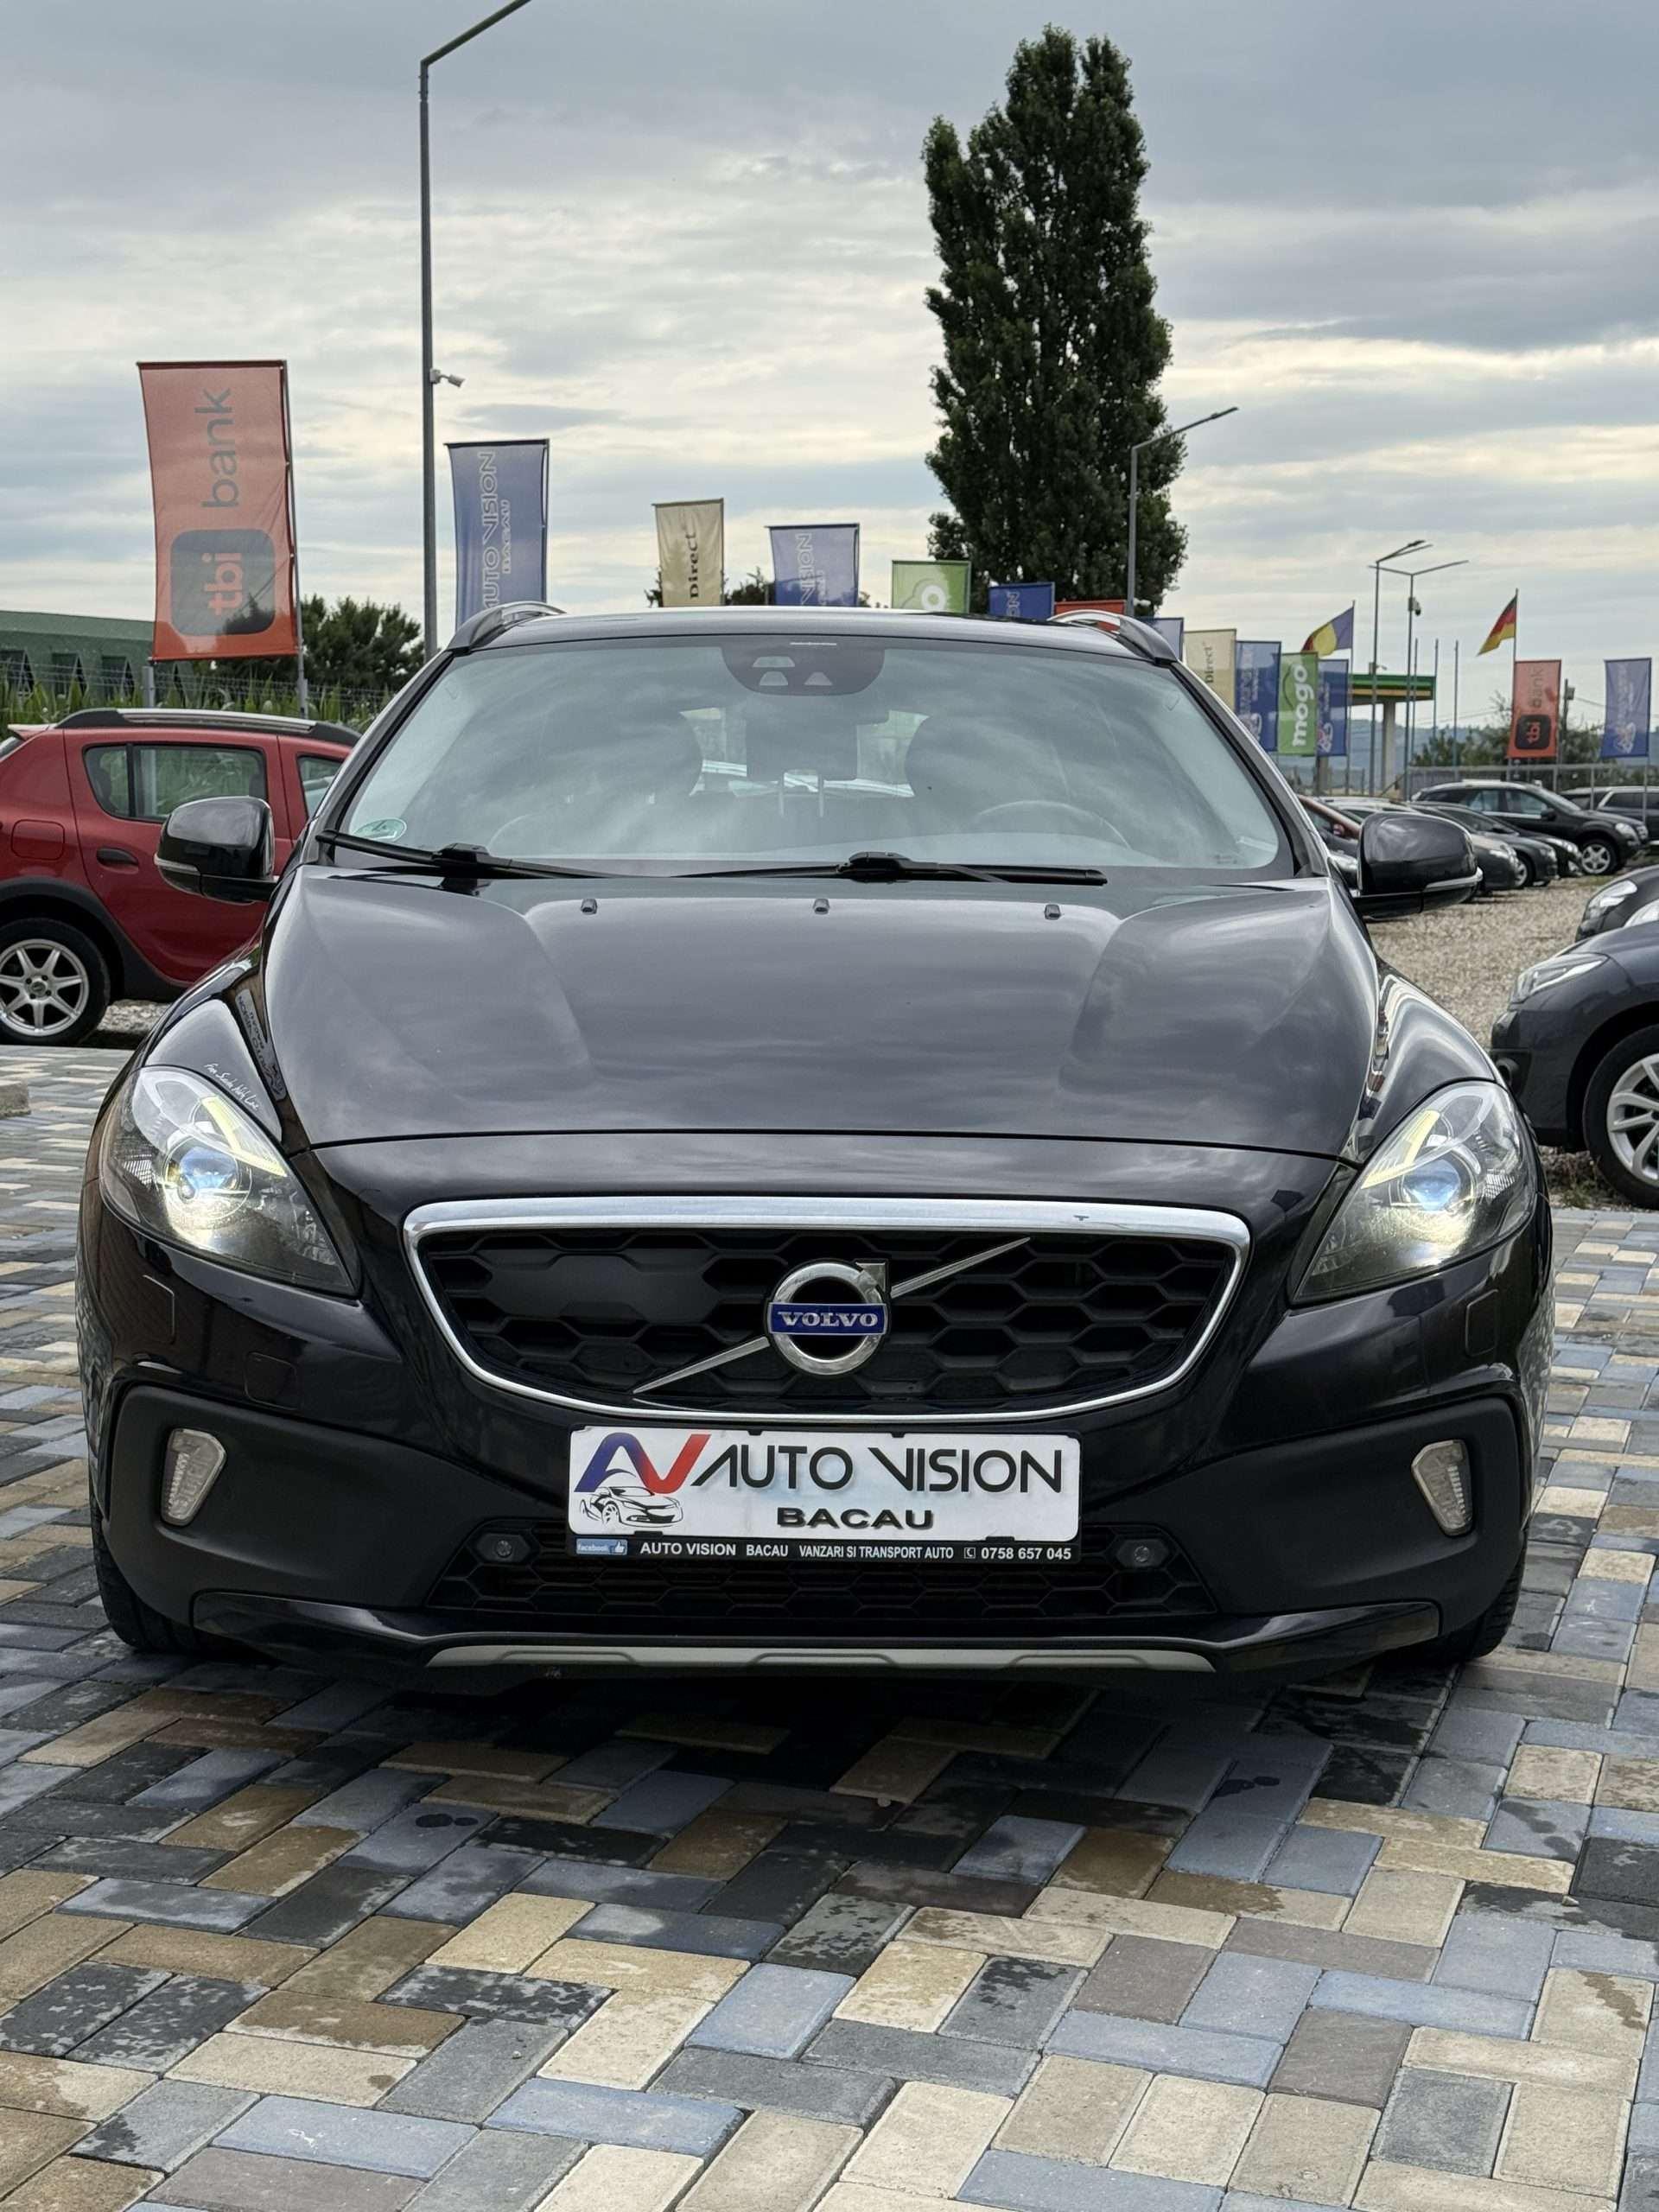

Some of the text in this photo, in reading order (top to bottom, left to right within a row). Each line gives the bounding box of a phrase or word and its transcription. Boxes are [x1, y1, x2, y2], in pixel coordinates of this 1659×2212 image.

[194, 387, 244, 616] tbi bank
[478, 451, 499, 545] VISION
[501, 499, 512, 574] BACAU
[685, 532, 699, 598] Direct
[1293, 664, 1313, 747] mogo
[778, 1312, 879, 1327] VOLVO
[690, 1444, 1062, 1493] AUTO VISION
[640, 1541, 1071, 1560] AUTO VISION BACAU VANZARI SI TRANSPORT AUTO 0758 657 045
[777, 1507, 933, 1530] BACAU
